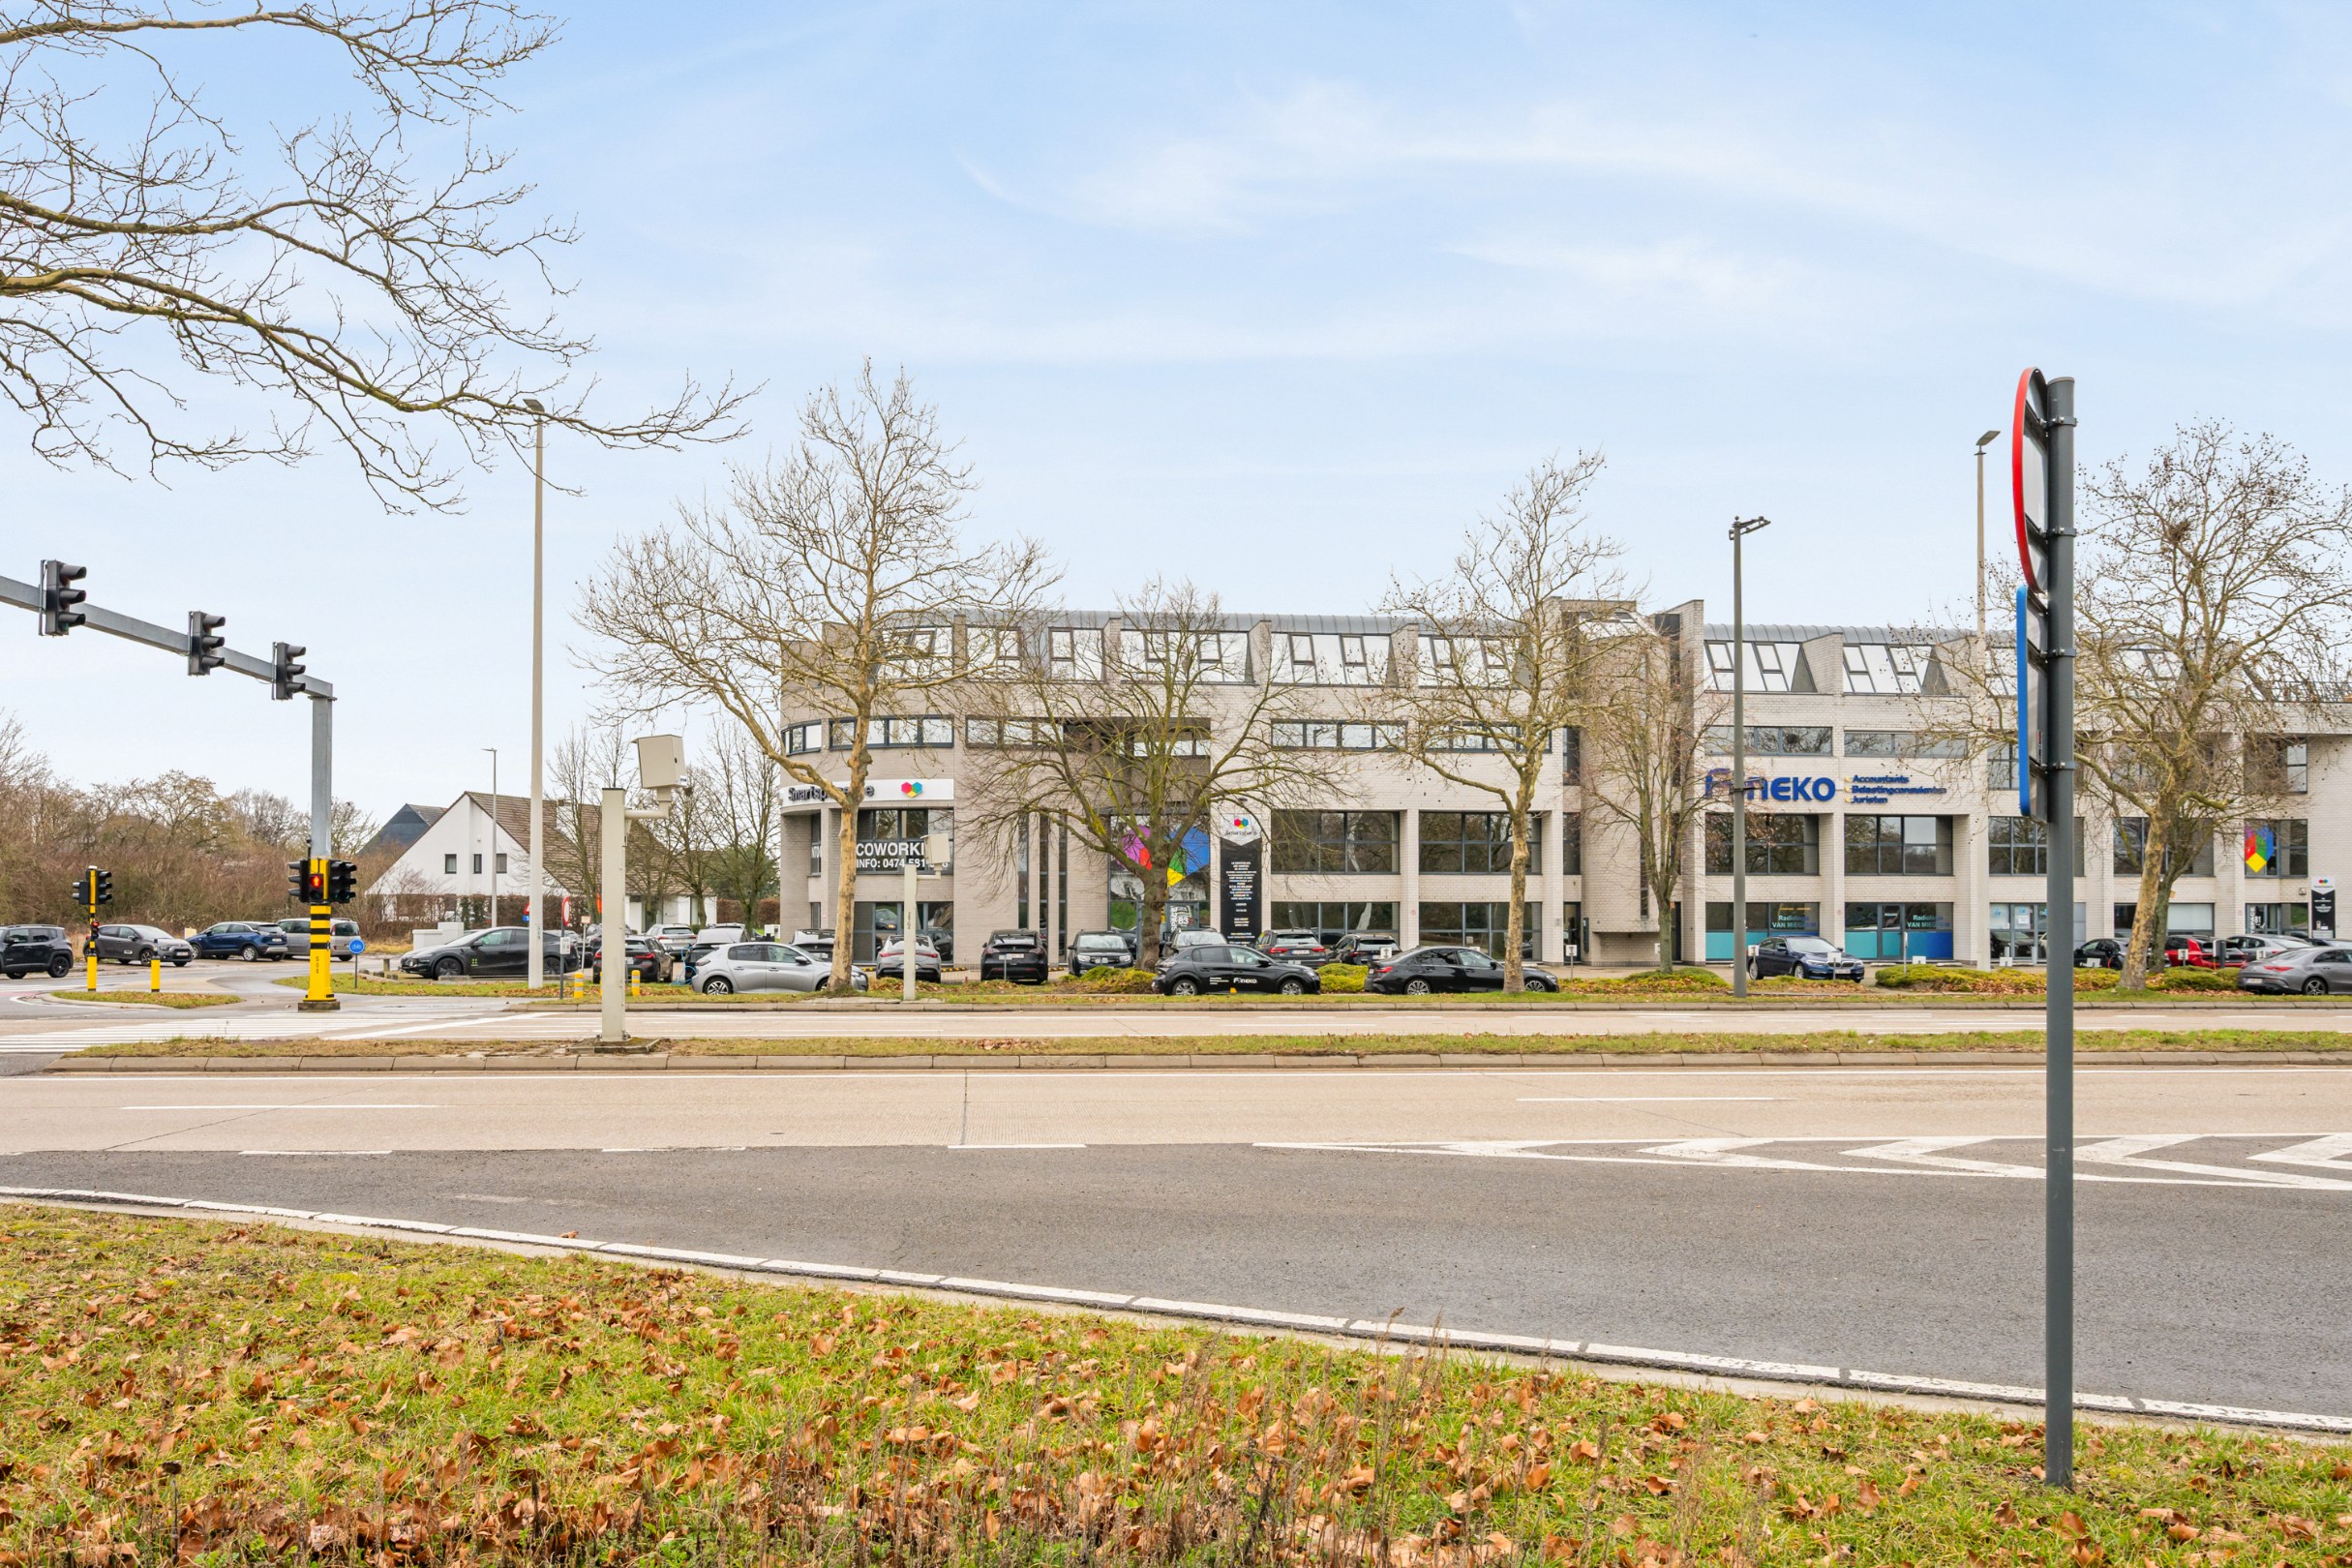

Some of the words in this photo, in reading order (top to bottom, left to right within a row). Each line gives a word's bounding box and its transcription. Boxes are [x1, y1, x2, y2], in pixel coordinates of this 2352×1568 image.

[1853, 774, 1910, 783] Accountants
[856, 842, 925, 856] COWORKI
[857, 859, 881, 868] INFO:
[883, 859, 906, 868] 0474
